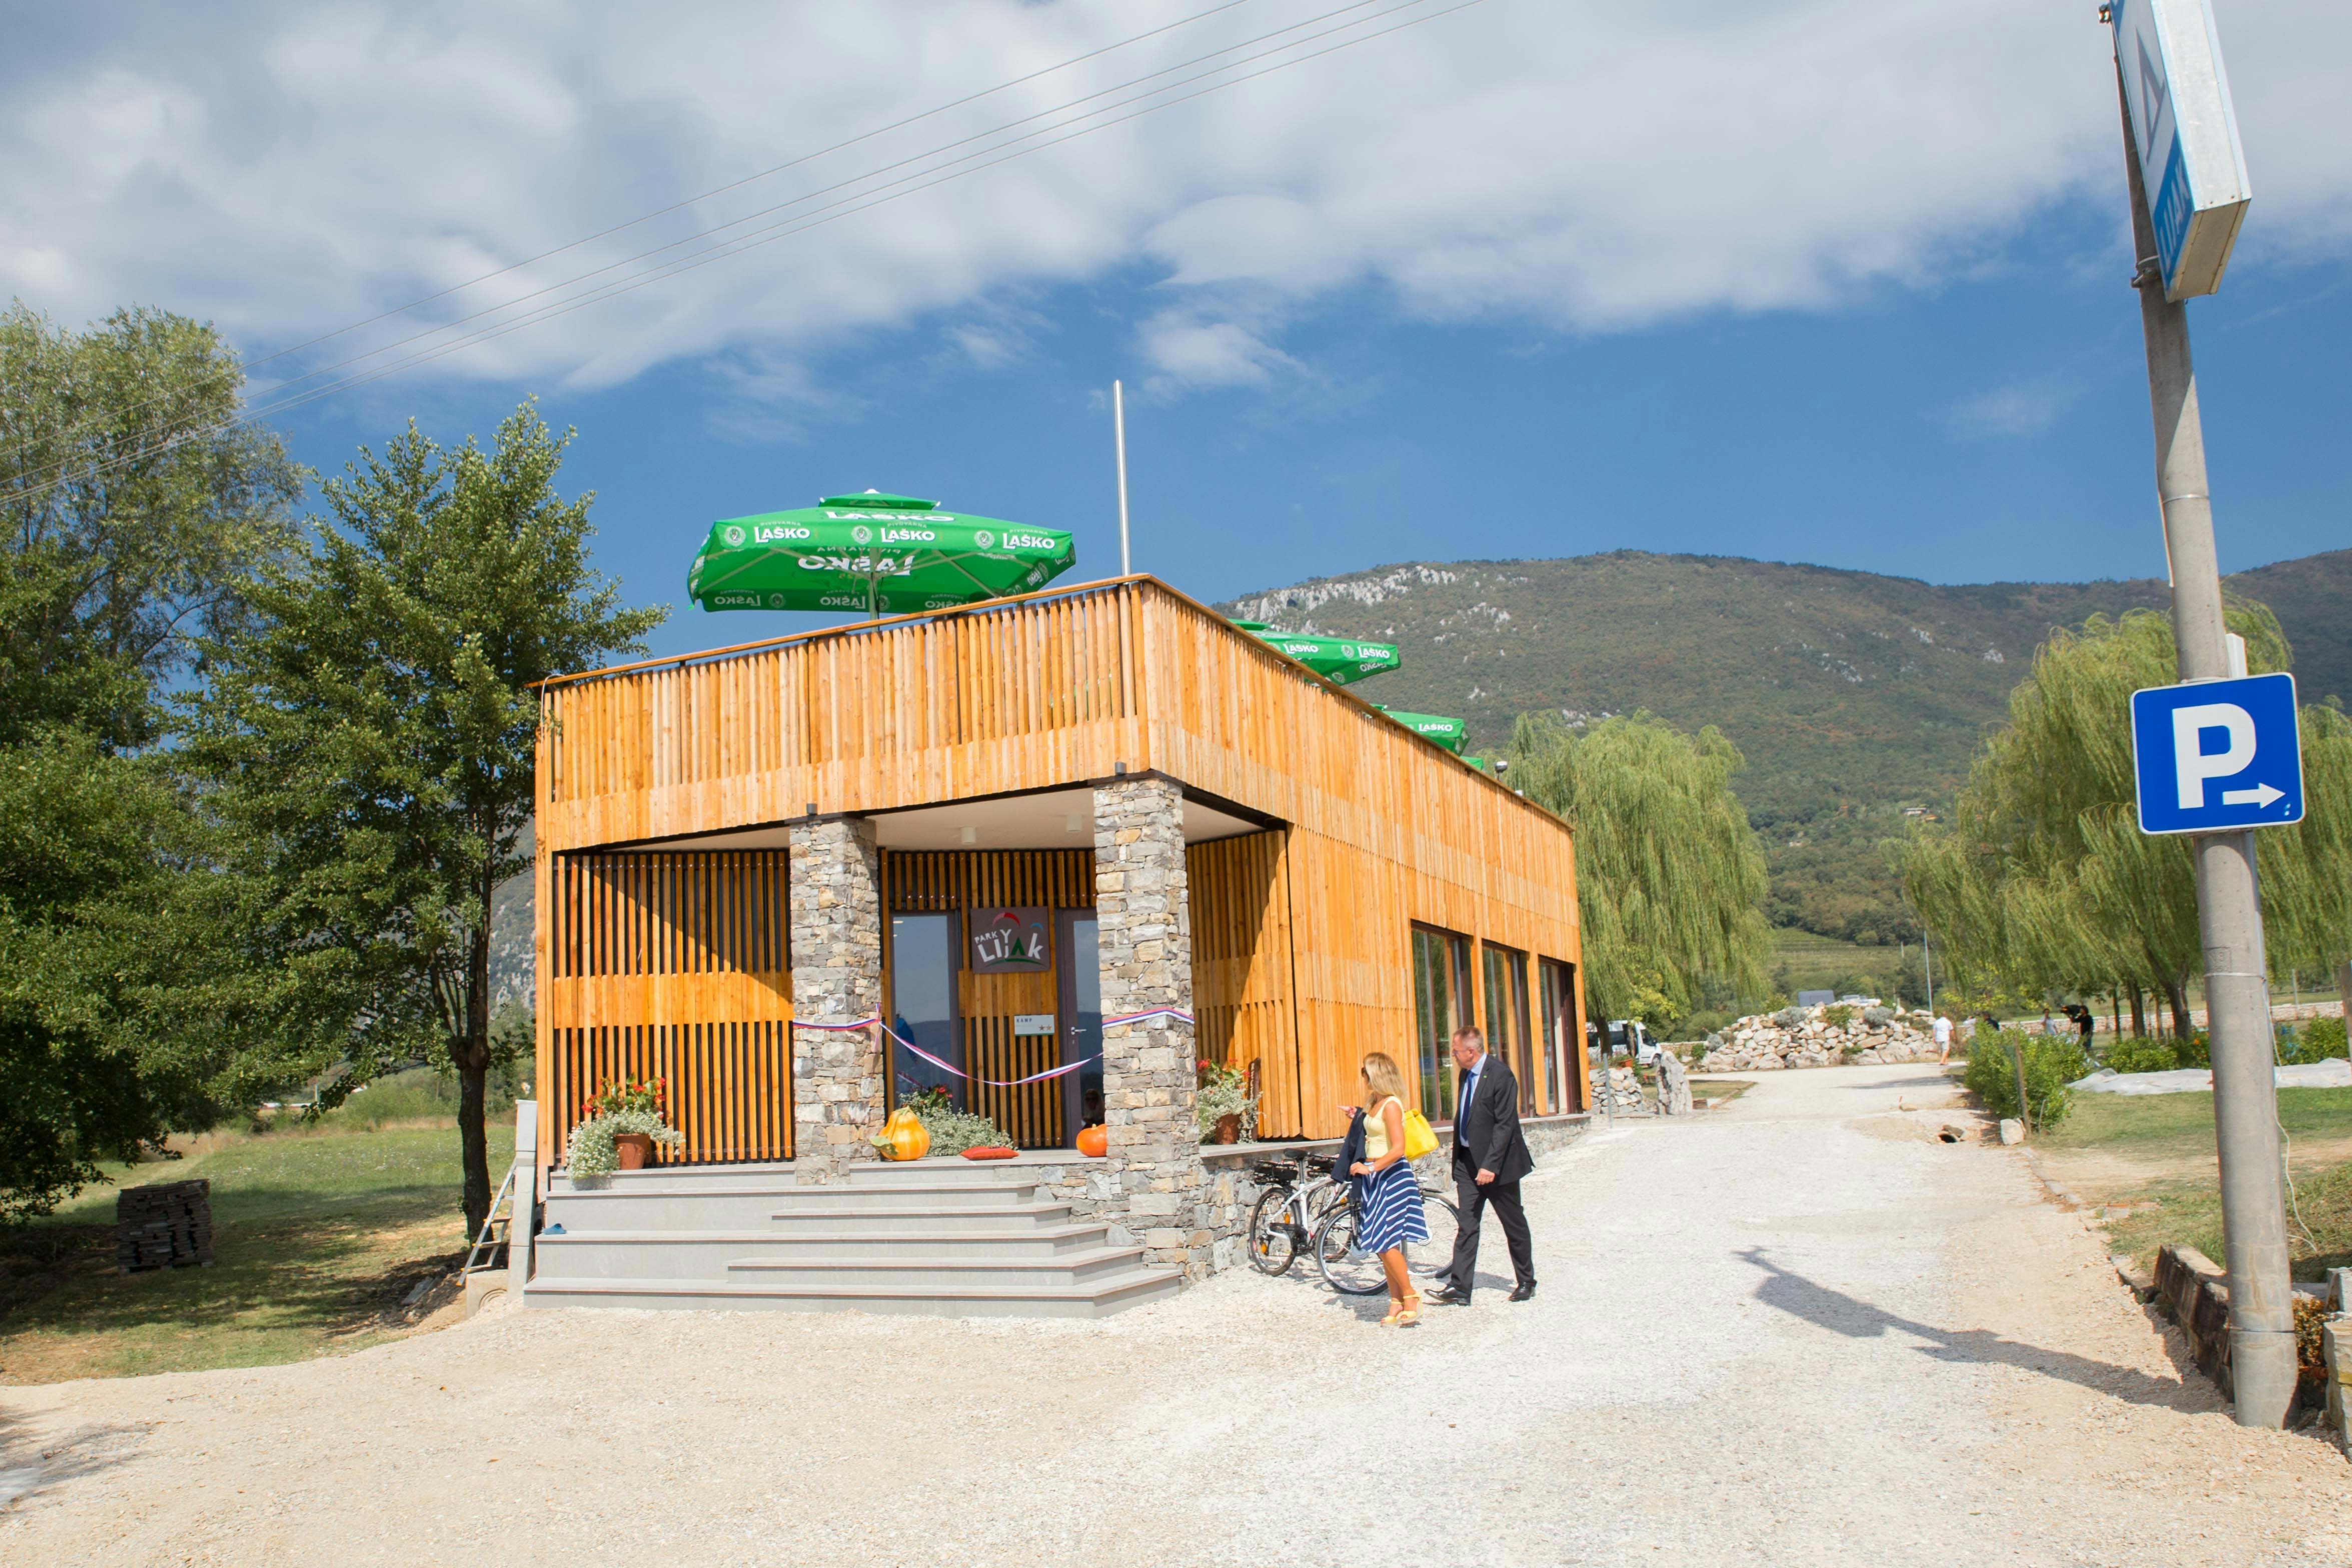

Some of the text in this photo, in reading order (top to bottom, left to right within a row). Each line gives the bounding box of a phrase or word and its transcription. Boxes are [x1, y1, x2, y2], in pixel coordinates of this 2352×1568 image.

[754, 526, 810, 543] LAŠKO
[880, 528, 935, 543] LAŠKO
[1002, 533, 1055, 549] LAŠKO
[2172, 703, 2256, 809] P
[974, 930, 998, 944] PARK
